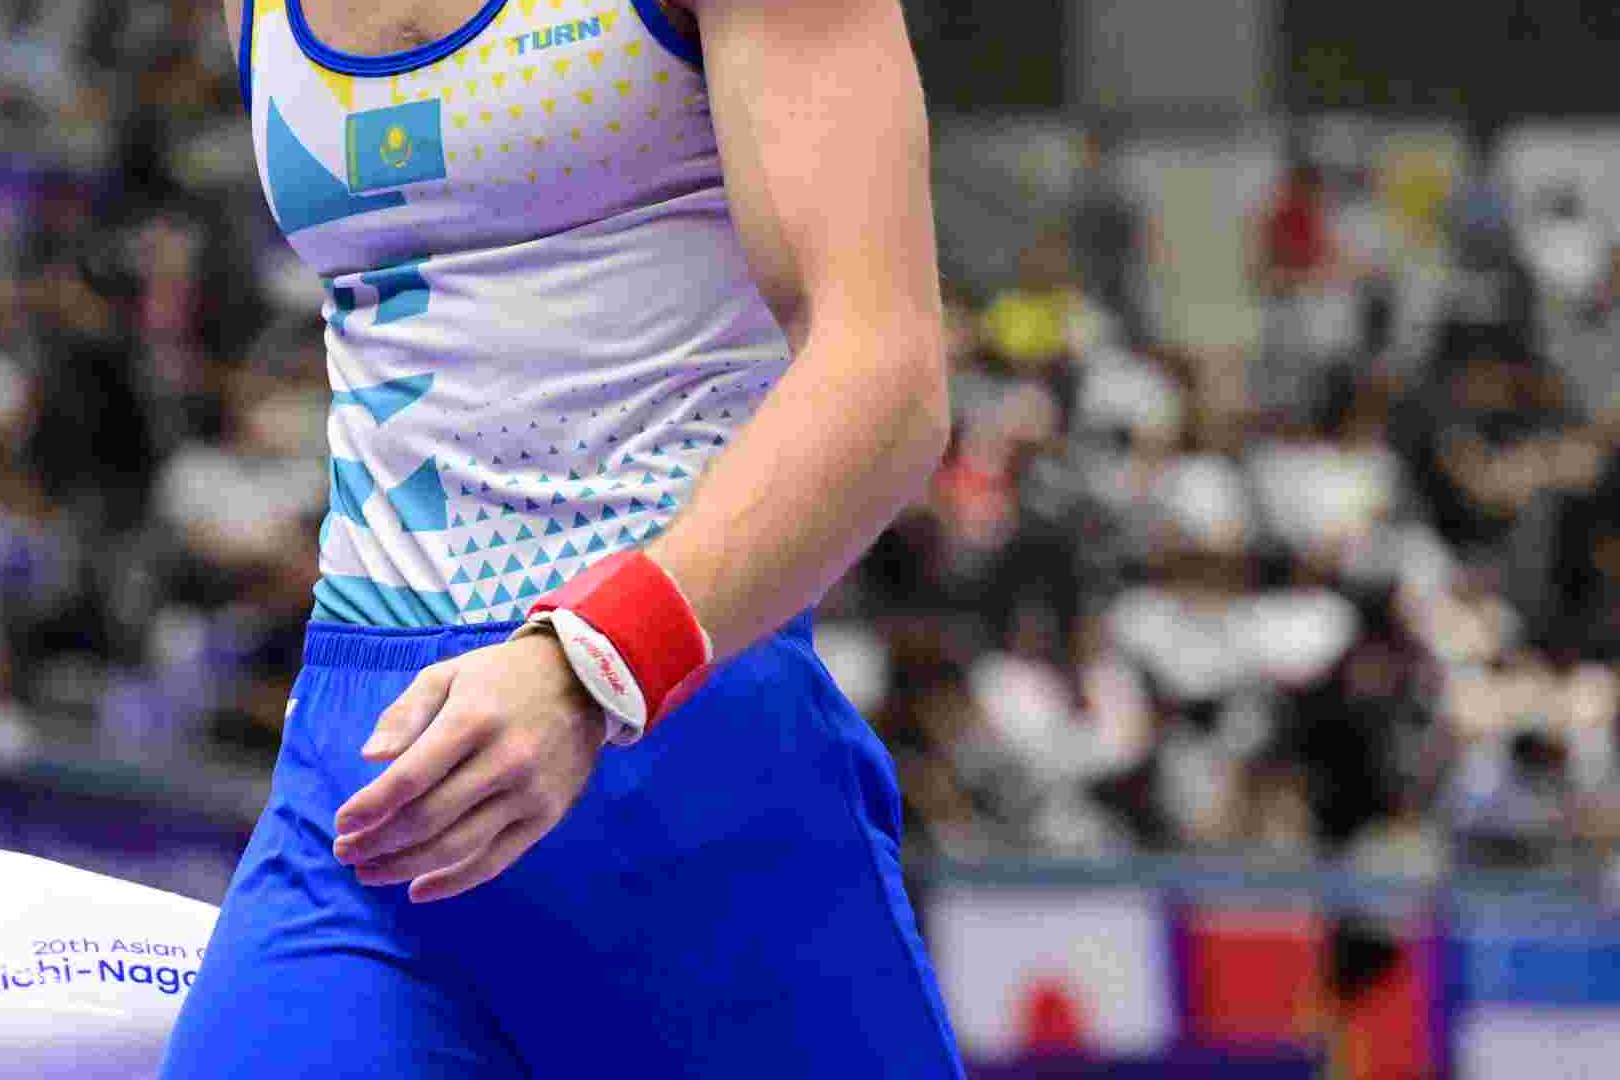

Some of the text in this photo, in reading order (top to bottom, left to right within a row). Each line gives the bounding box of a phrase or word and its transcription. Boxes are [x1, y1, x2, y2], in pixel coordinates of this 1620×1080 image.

[510, 16, 602, 55] TURN
[32, 937, 99, 956] 20th
[110, 938, 186, 959] Asian
